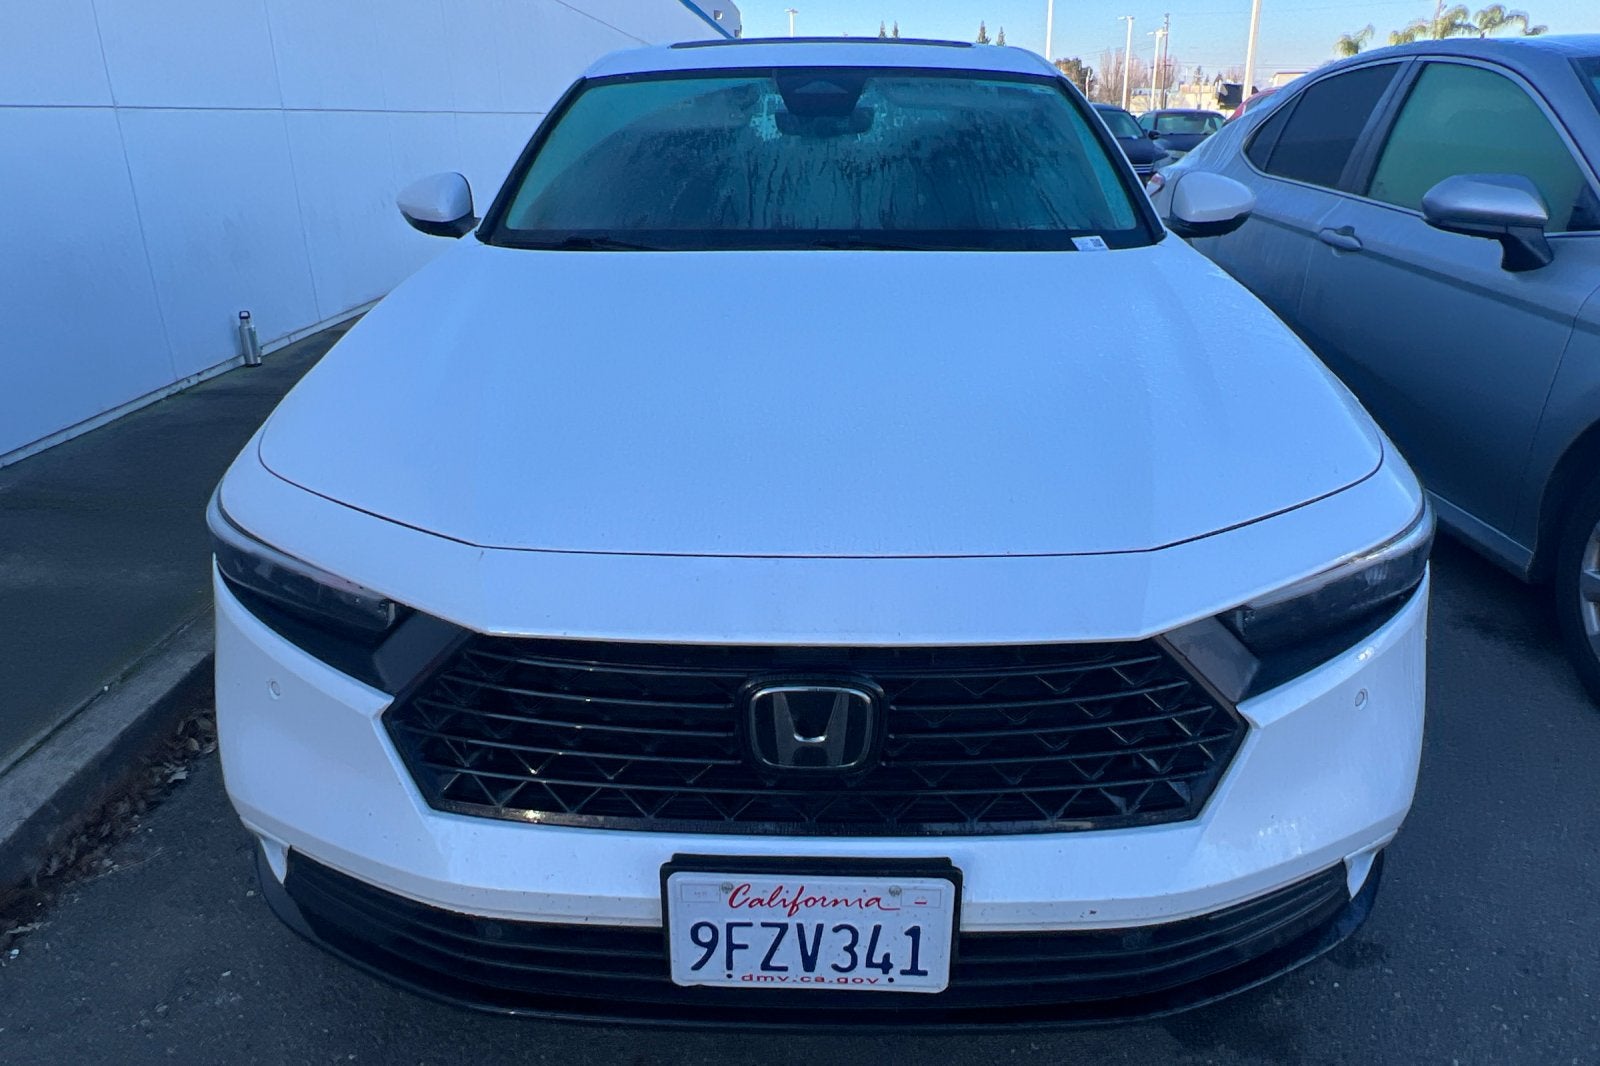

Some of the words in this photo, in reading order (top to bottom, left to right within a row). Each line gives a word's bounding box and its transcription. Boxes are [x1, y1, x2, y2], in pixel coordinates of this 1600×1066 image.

[728, 883, 900, 917] California
[689, 921, 928, 977] 9FZV341
[741, 973, 880, 985] dmv.ca.gov
